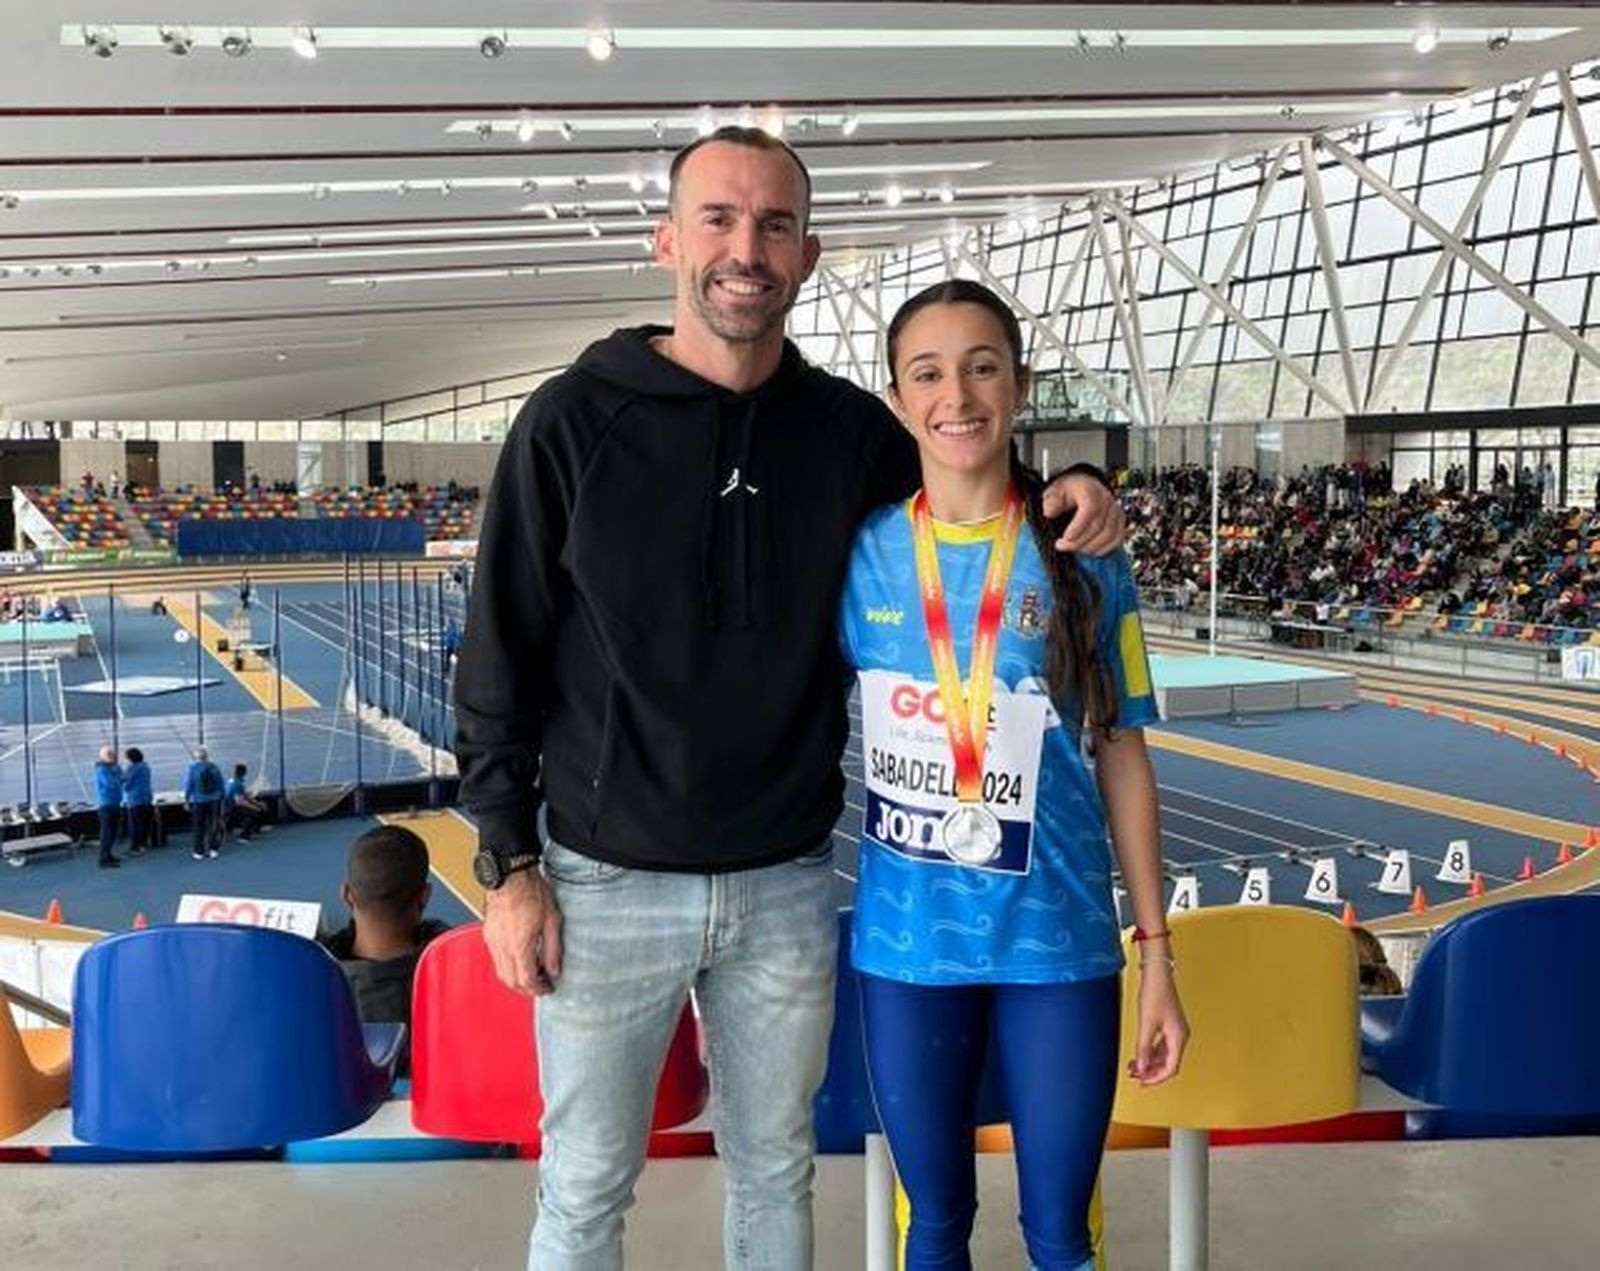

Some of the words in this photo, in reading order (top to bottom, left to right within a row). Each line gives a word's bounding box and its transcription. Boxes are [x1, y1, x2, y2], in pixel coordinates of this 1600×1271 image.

[982, 771, 1022, 806] 024
[1391, 861, 1404, 882] 7
[1450, 851, 1464, 872] 8
[1248, 879, 1263, 901] 5
[1315, 872, 1330, 893] 6
[1176, 889, 1190, 910] 4
